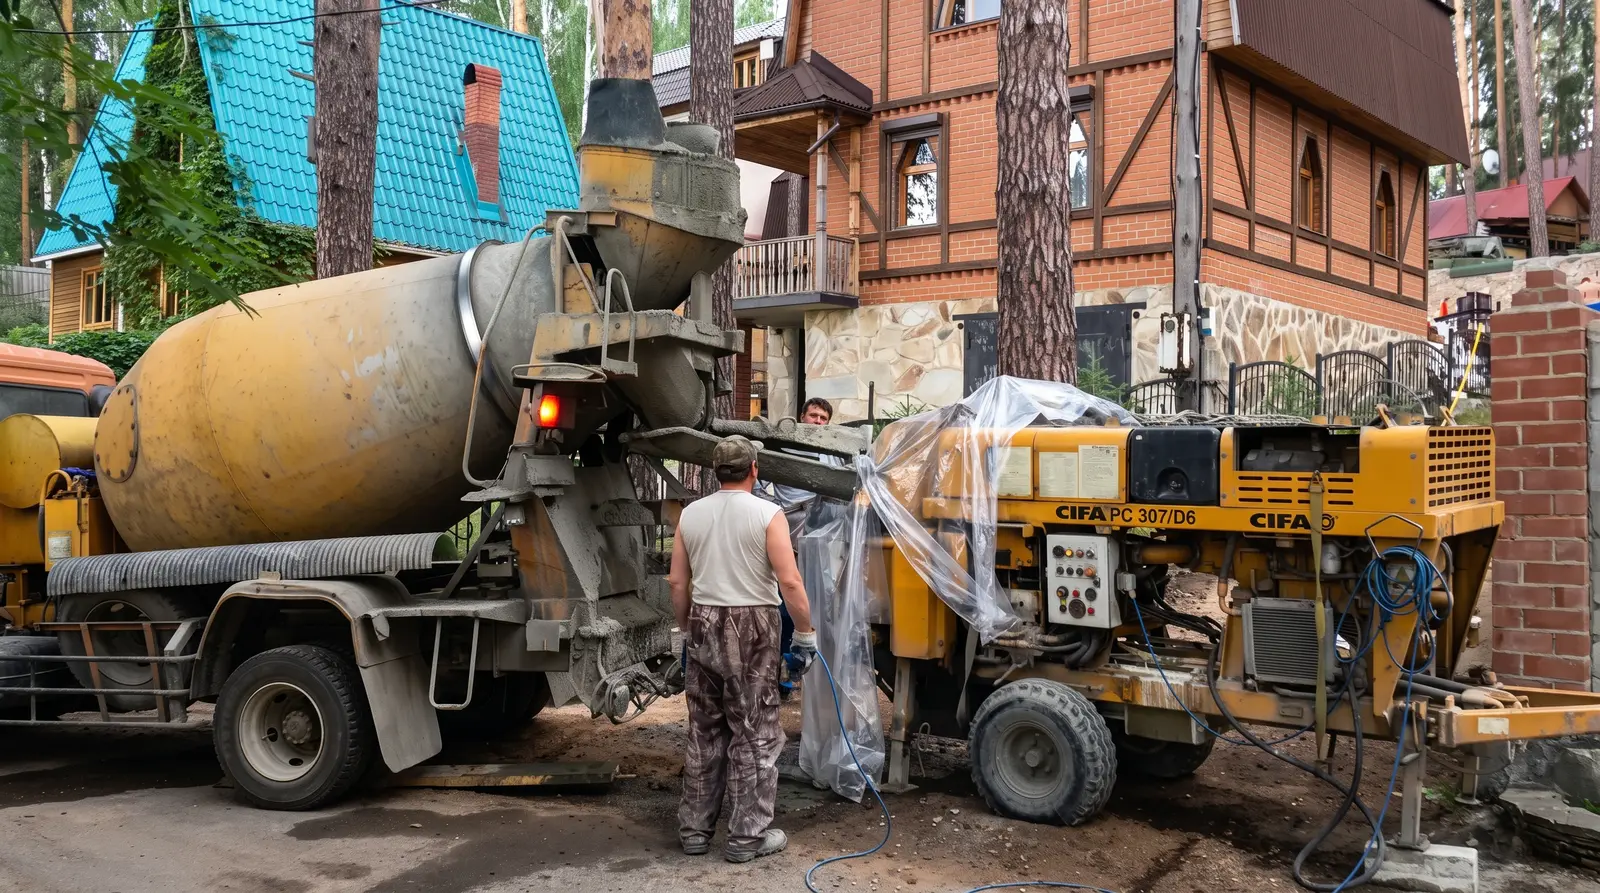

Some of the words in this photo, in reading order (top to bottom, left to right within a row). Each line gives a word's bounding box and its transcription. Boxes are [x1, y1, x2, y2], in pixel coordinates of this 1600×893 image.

[1055, 505, 1107, 521] CIFA
[1110, 507, 1133, 522] PC
[1138, 508, 1196, 525] 307/D6
[1249, 513, 1312, 530] CIFA
